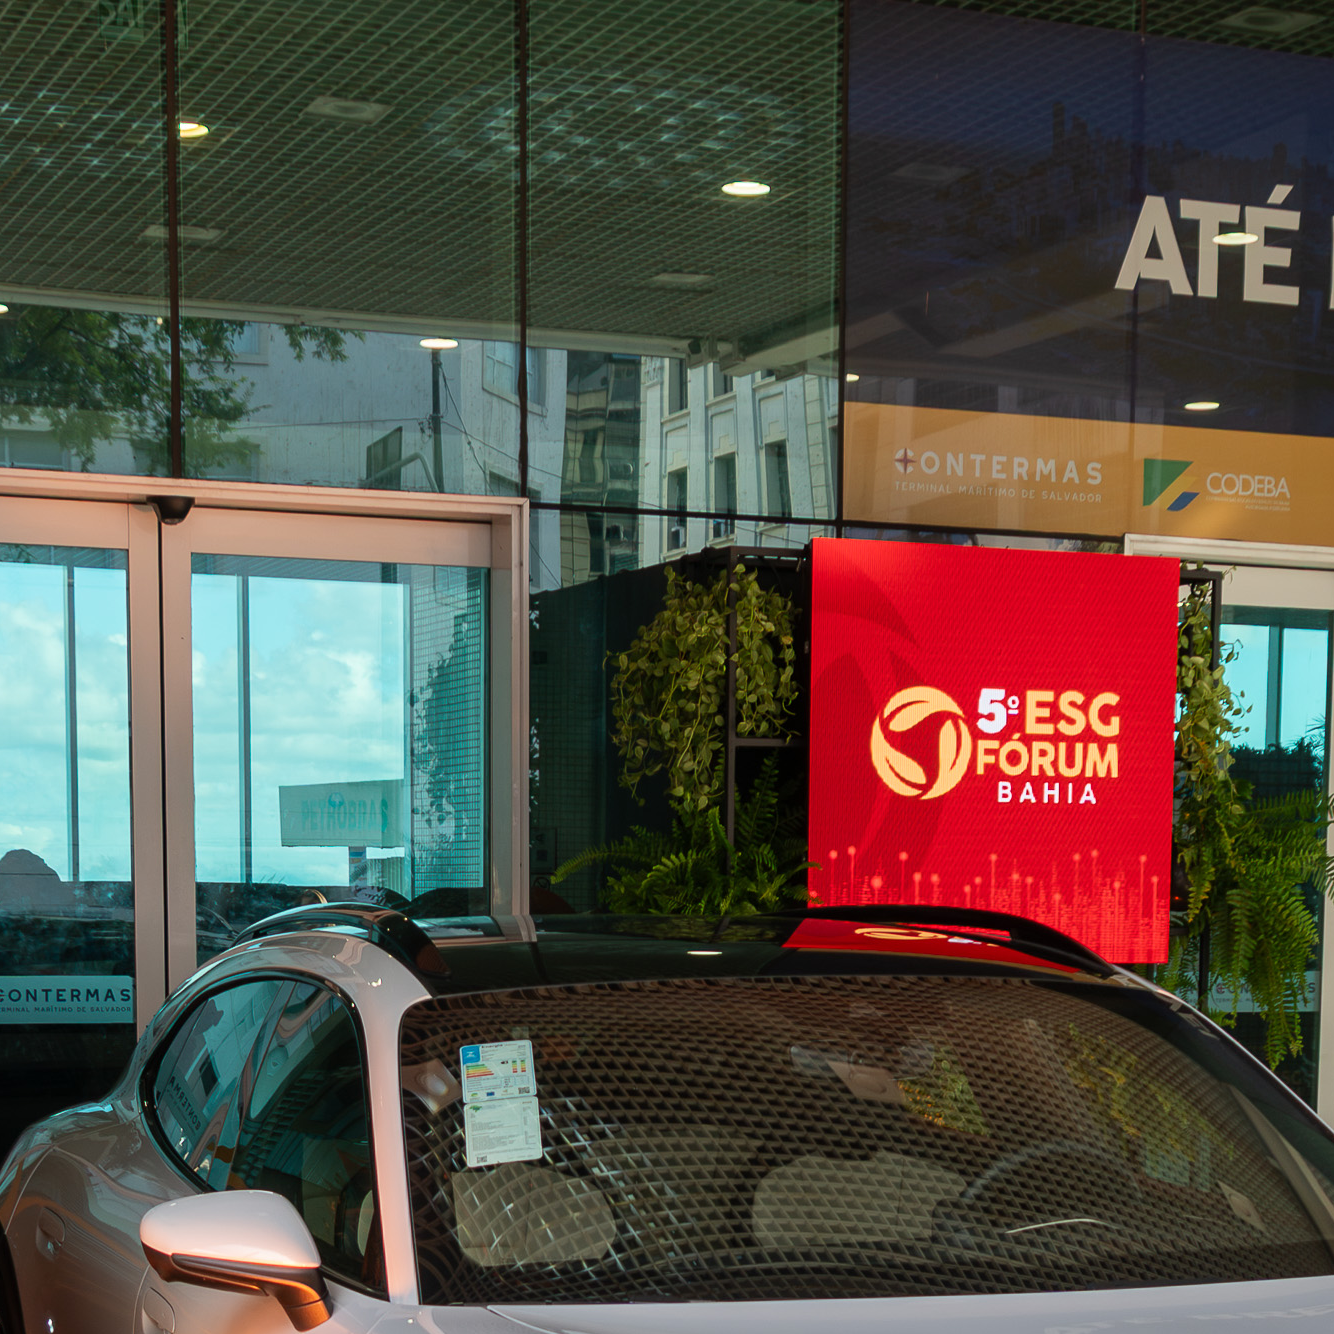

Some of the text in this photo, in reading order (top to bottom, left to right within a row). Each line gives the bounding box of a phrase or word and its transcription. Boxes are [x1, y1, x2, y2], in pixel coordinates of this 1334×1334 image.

[1114, 183, 1301, 307] ATÉ
[894, 447, 1102, 486] CONTERMAS
[1206, 472, 1291, 499] CODEBA
[895, 481, 1102, 503] TERMINAL MARÍTIMO DE SALVADOR
[1025, 689, 1121, 737] ESG
[976, 733, 1119, 778] FÓRUM
[997, 781, 1097, 804] BAHIA
